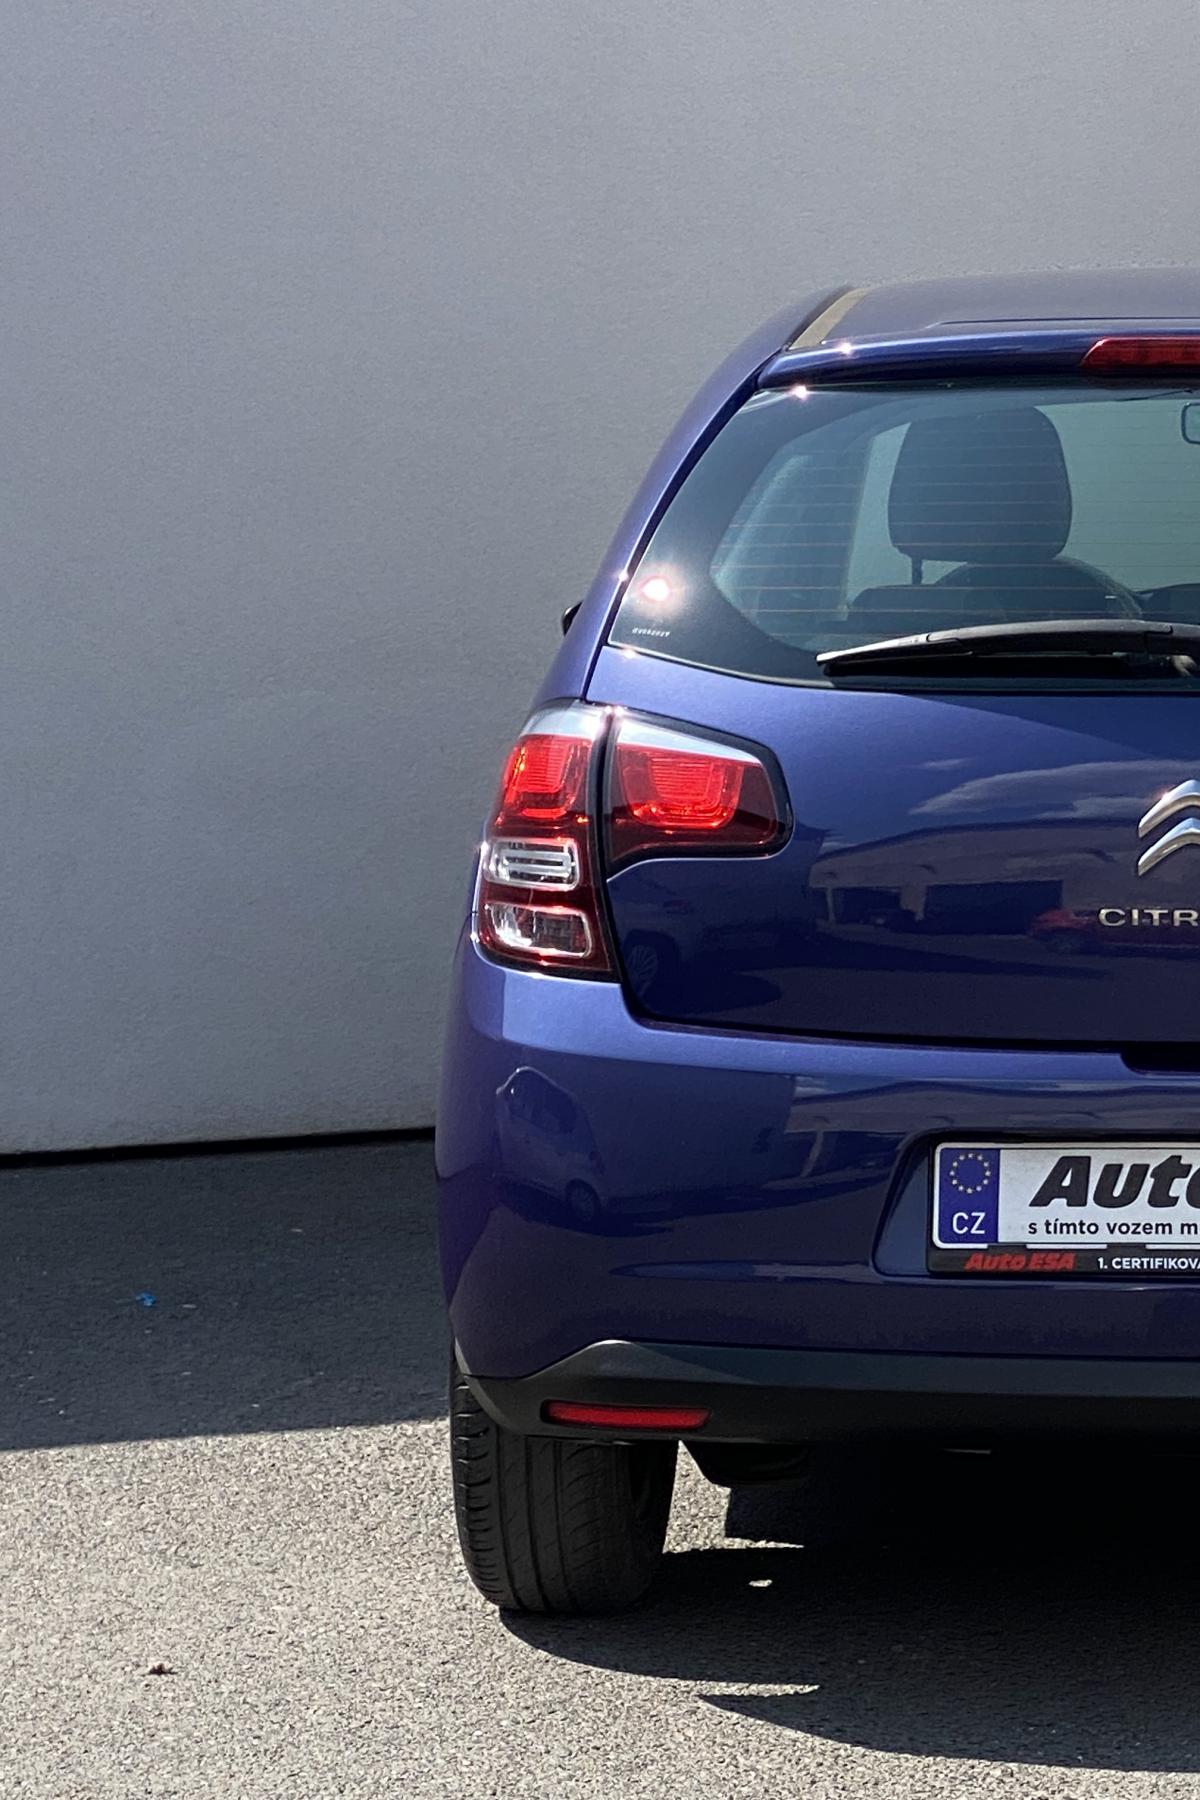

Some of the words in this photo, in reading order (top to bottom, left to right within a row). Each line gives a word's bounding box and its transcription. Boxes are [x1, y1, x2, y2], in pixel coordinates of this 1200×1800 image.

[952, 1212, 986, 1234] CZ
[1027, 1222, 1037, 1235] s
[1044, 1218, 1099, 1235] tímto
[1106, 1222, 1173, 1235] vozem
[964, 1253, 1027, 1271] Auto
[1028, 1253, 1076, 1271] ESA
[1097, 1257, 1108, 1269] 1.
